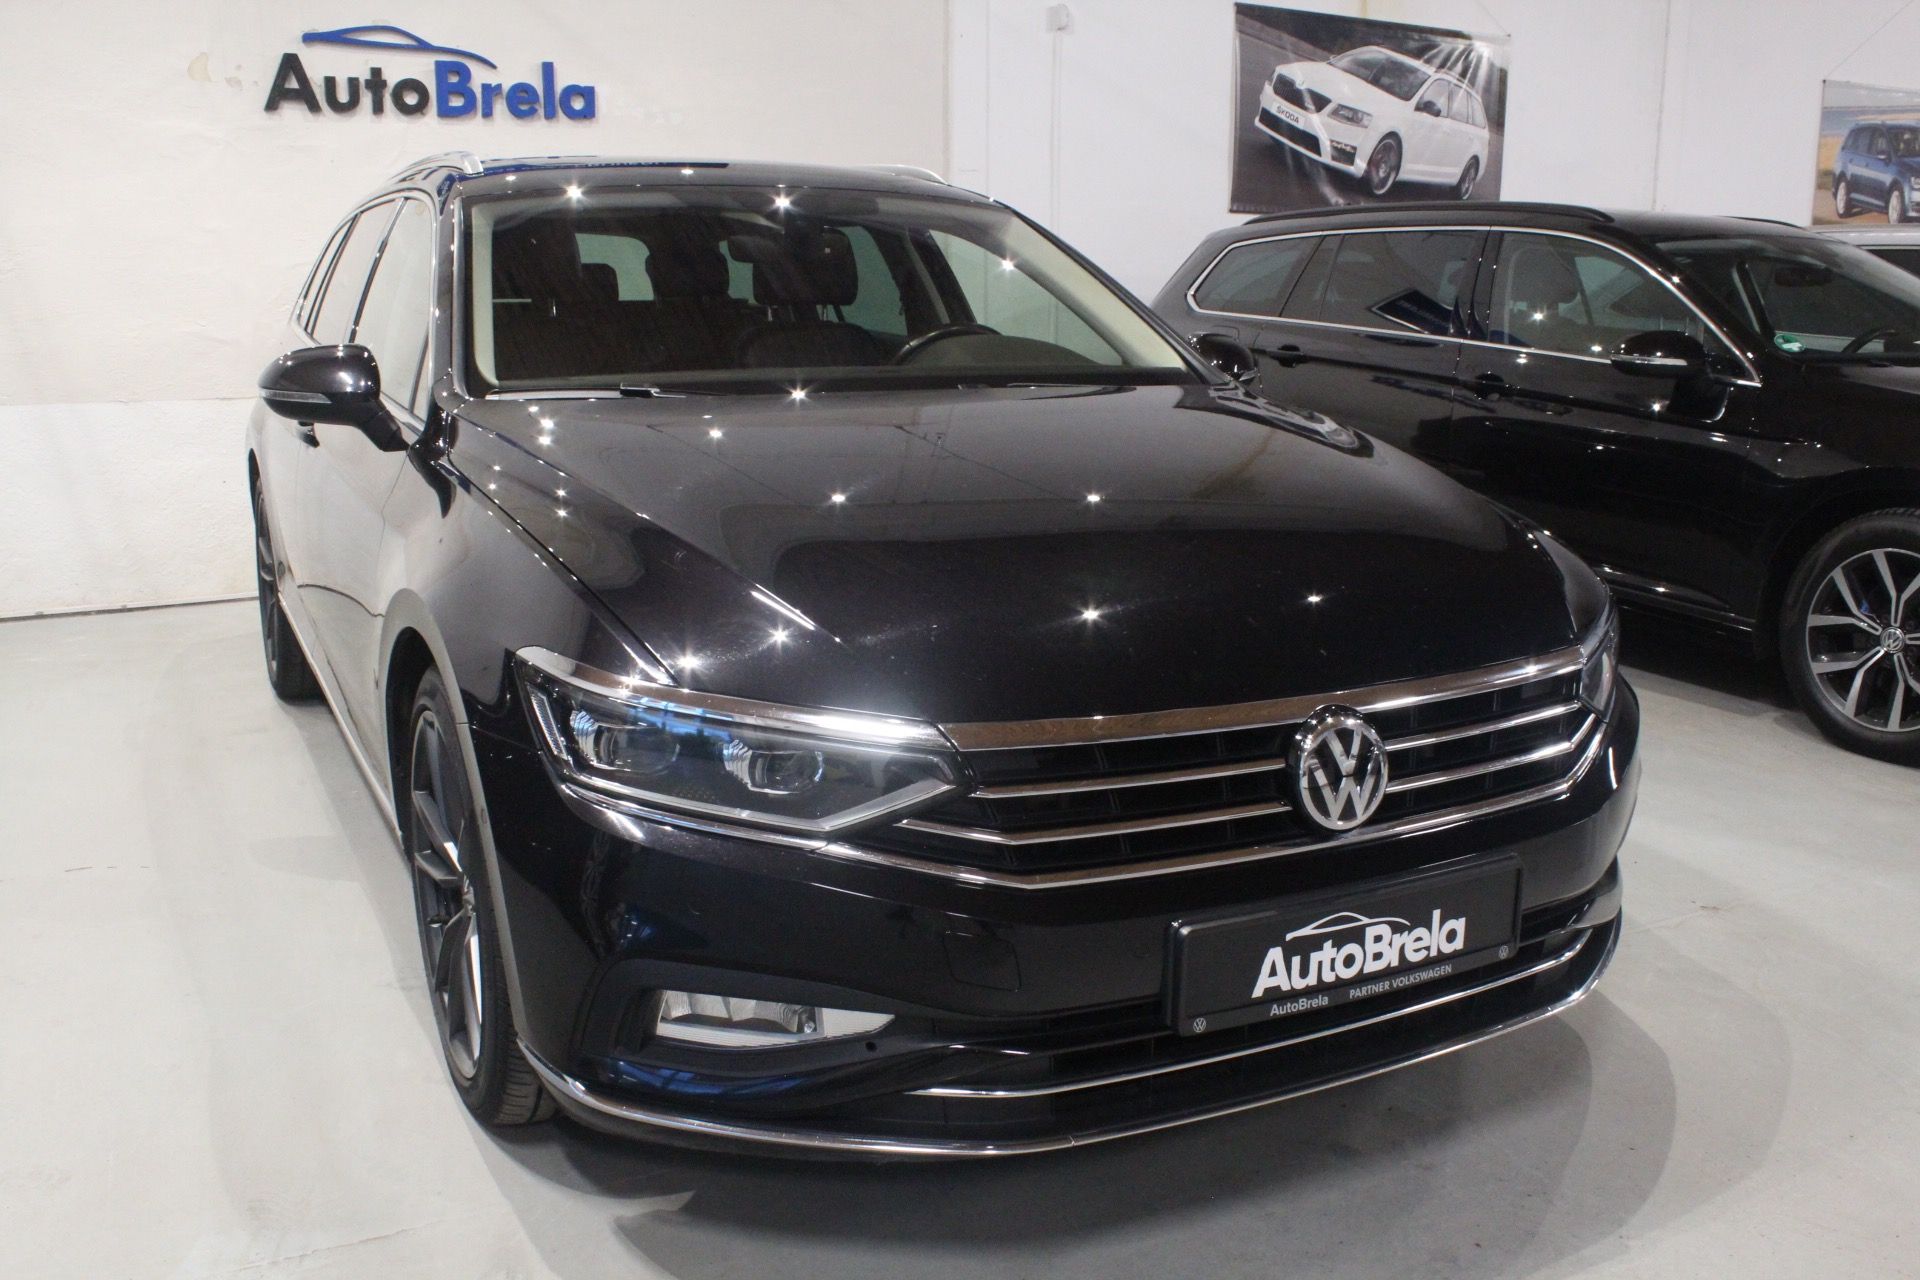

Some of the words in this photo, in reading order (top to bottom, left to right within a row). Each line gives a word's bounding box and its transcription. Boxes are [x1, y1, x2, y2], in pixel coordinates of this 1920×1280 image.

[264, 52, 596, 120] AutoBrela
[1251, 908, 1466, 999] AutoBrela
[1269, 994, 1329, 1017] AutoBrela
[1349, 981, 1391, 1000] PARTNER
[1392, 964, 1452, 989] VOLKSWAGEN
